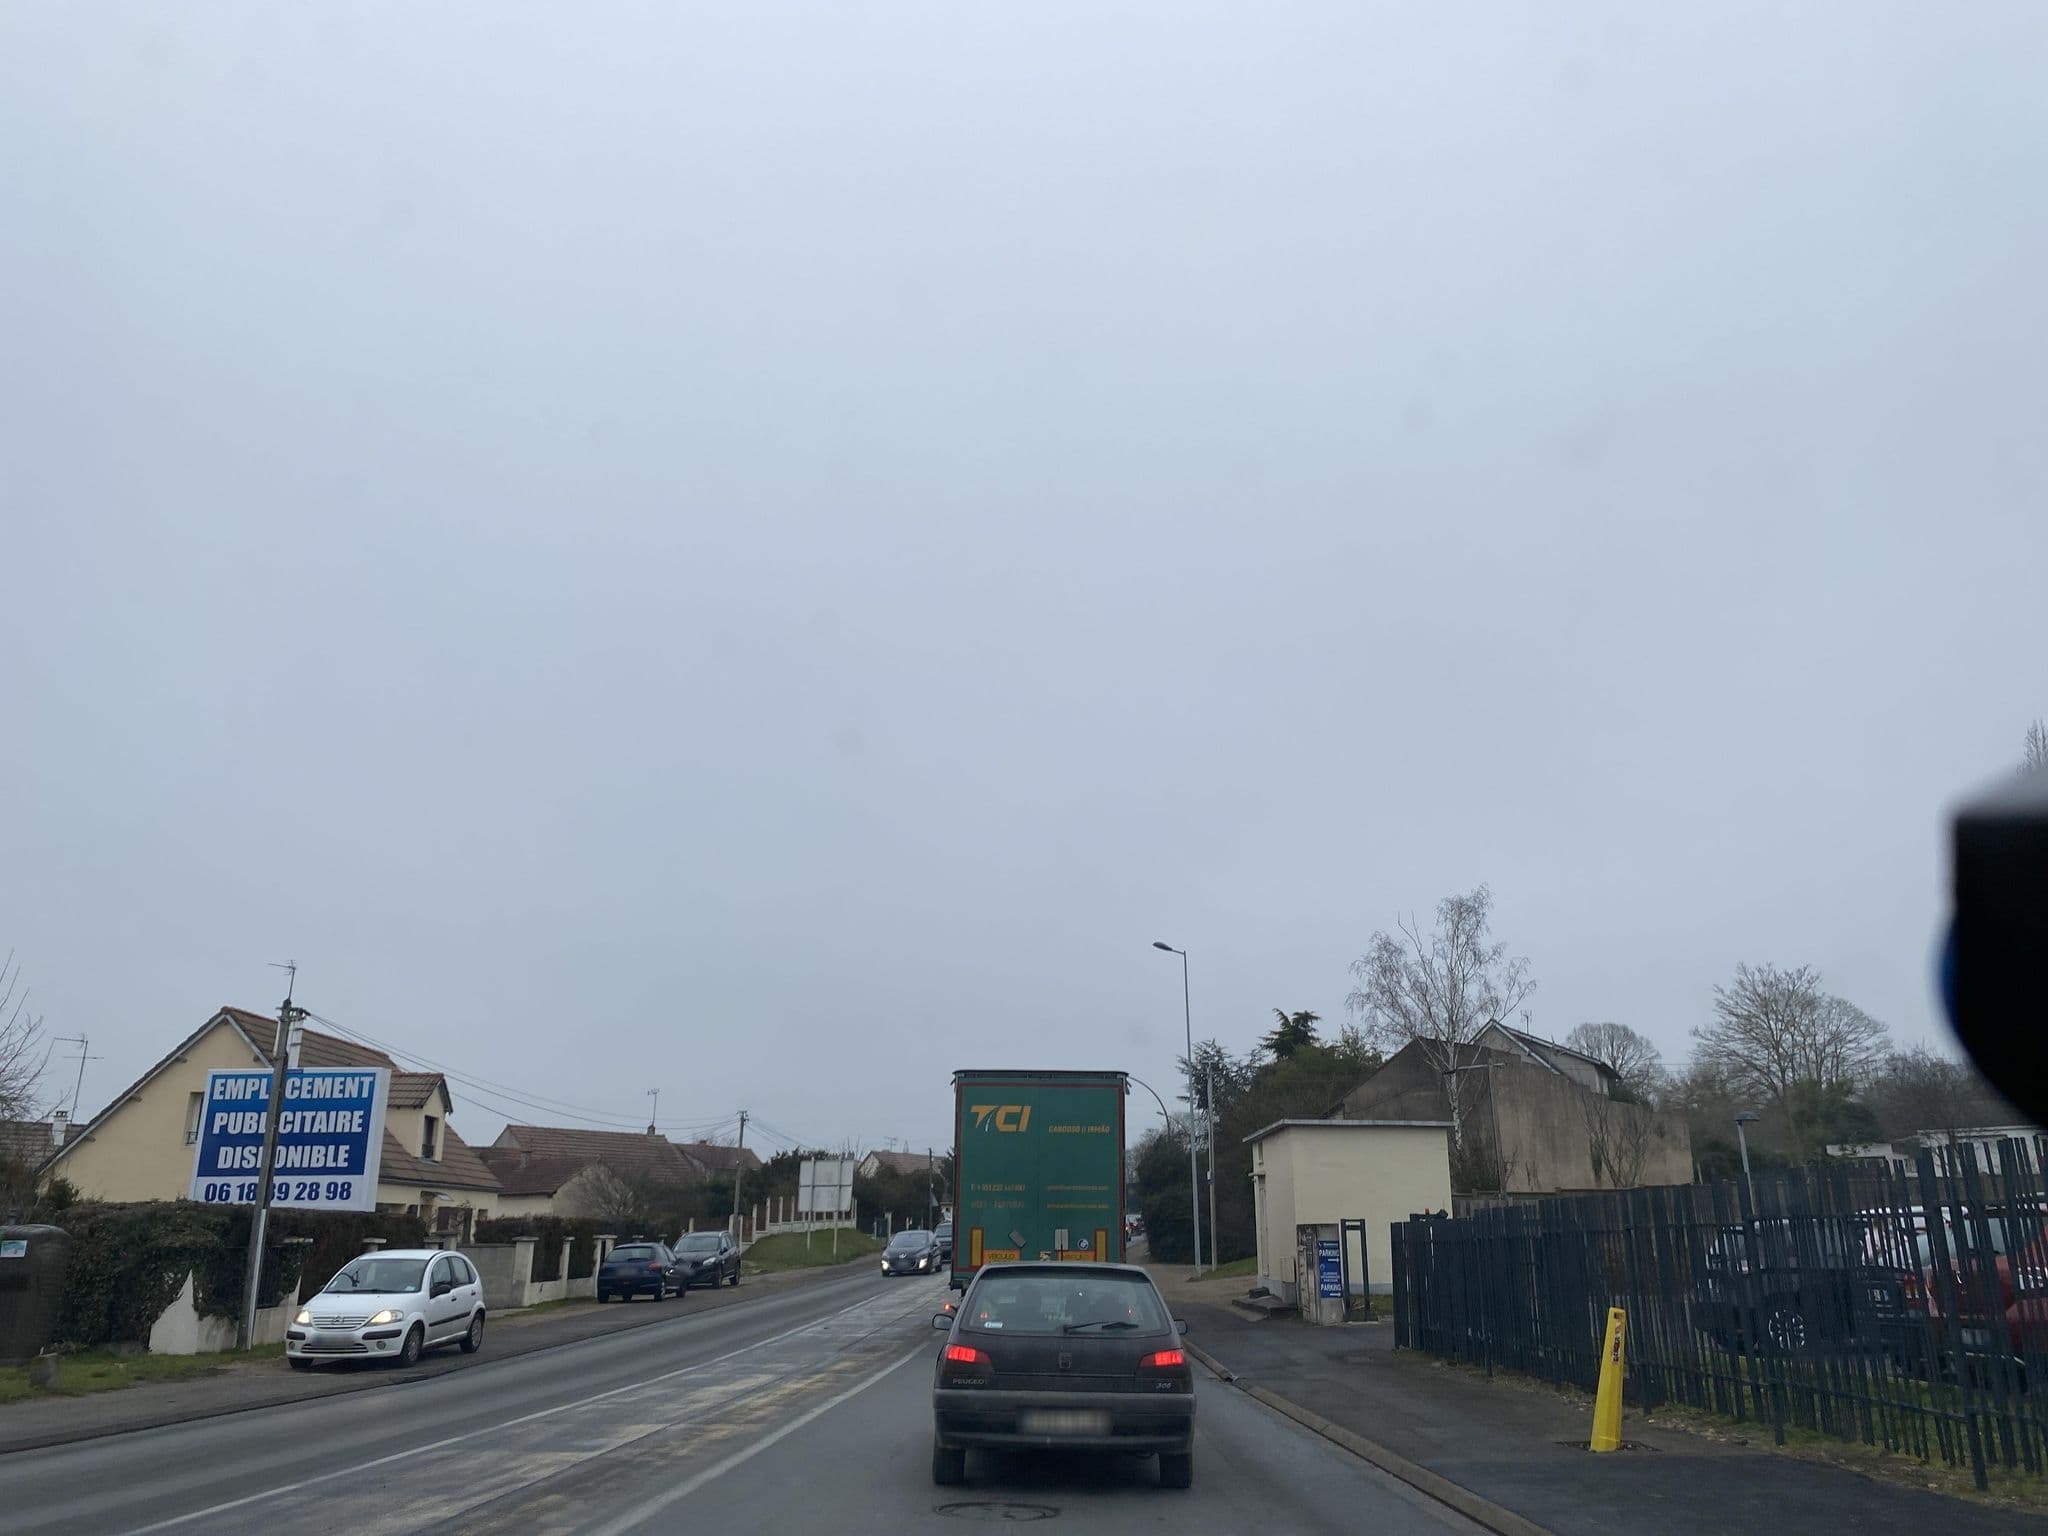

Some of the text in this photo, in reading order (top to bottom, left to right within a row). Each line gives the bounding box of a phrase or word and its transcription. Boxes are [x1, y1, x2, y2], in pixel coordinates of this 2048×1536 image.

[212, 1076, 374, 1100] EMPLCEMENT
[212, 1110, 364, 1135] PUBLCITAIRE
[969, 1104, 1032, 1133] TCI
[204, 1182, 231, 1202] 06
[236, 1182, 257, 1202] 18
[294, 1182, 321, 1201] 28
[325, 1181, 352, 1201] 98
